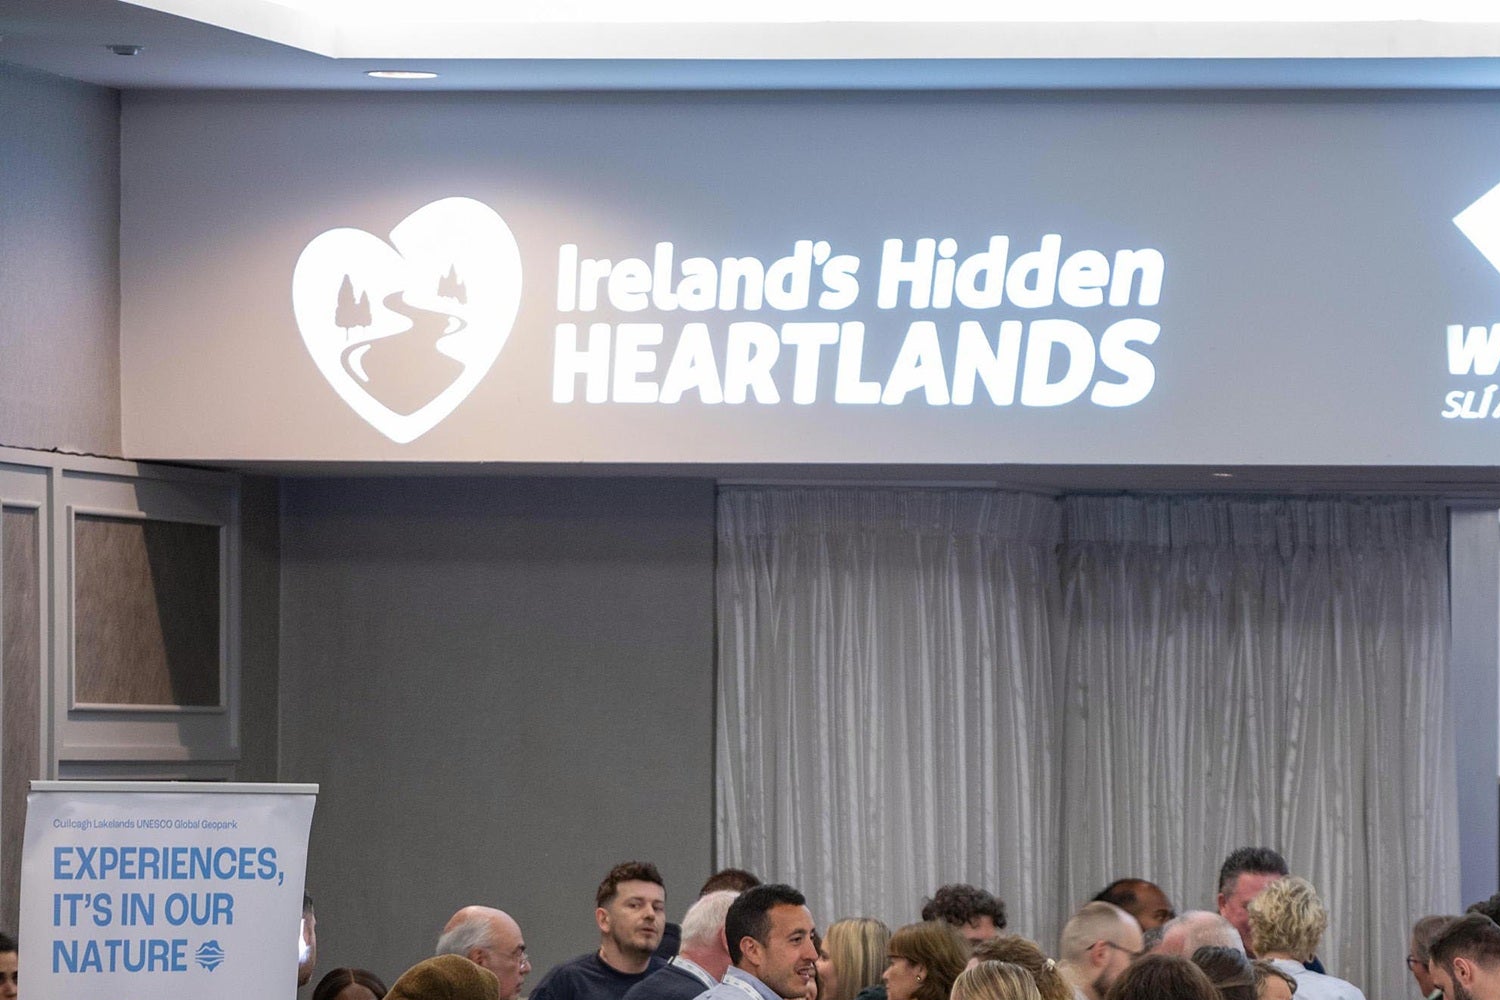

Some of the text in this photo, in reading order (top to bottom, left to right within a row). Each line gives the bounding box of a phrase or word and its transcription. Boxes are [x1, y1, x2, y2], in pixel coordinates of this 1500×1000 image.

[557, 234, 1164, 312] Ireland's Hidden
[553, 319, 1160, 406] HEARTLANDS
[1441, 384, 1498, 418] SLÍ
[53, 817, 238, 832] Cuilcagh Lakelands UNESCO Global Geopark
[53, 846, 285, 887] EXPERIENCES,
[53, 892, 234, 927] IT'S IN OUR
[52, 938, 188, 974] NATURE
